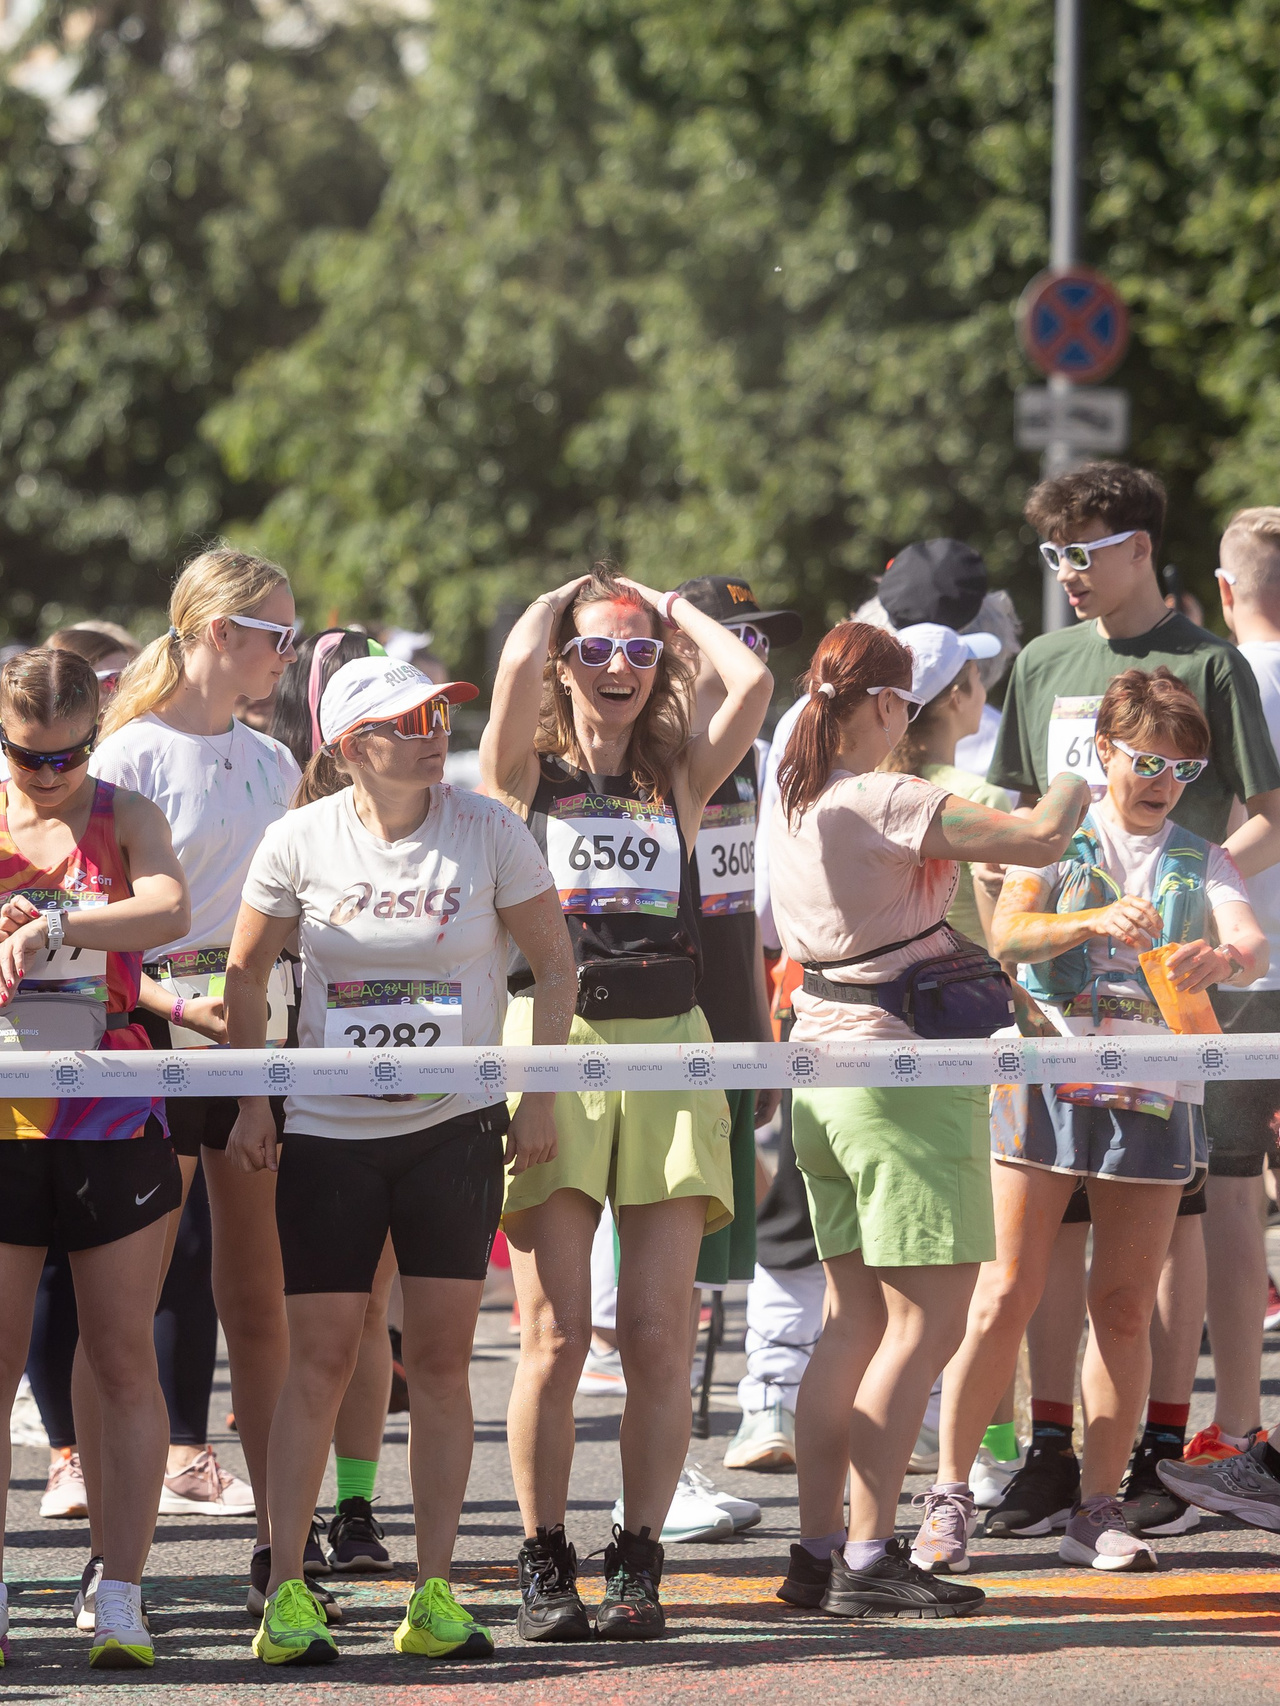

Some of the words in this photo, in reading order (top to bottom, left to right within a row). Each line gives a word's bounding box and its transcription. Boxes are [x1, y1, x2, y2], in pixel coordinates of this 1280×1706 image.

[1065, 736, 1096, 767] 61
[559, 796, 665, 817] КРАСОЧНЫЙ
[621, 811, 675, 825] 2026
[569, 835, 660, 872] 6569
[373, 887, 461, 919] asics
[337, 982, 450, 999] КРАСОЧНЫЙ
[400, 996, 459, 1005] 2026
[344, 1022, 441, 1048] 3282
